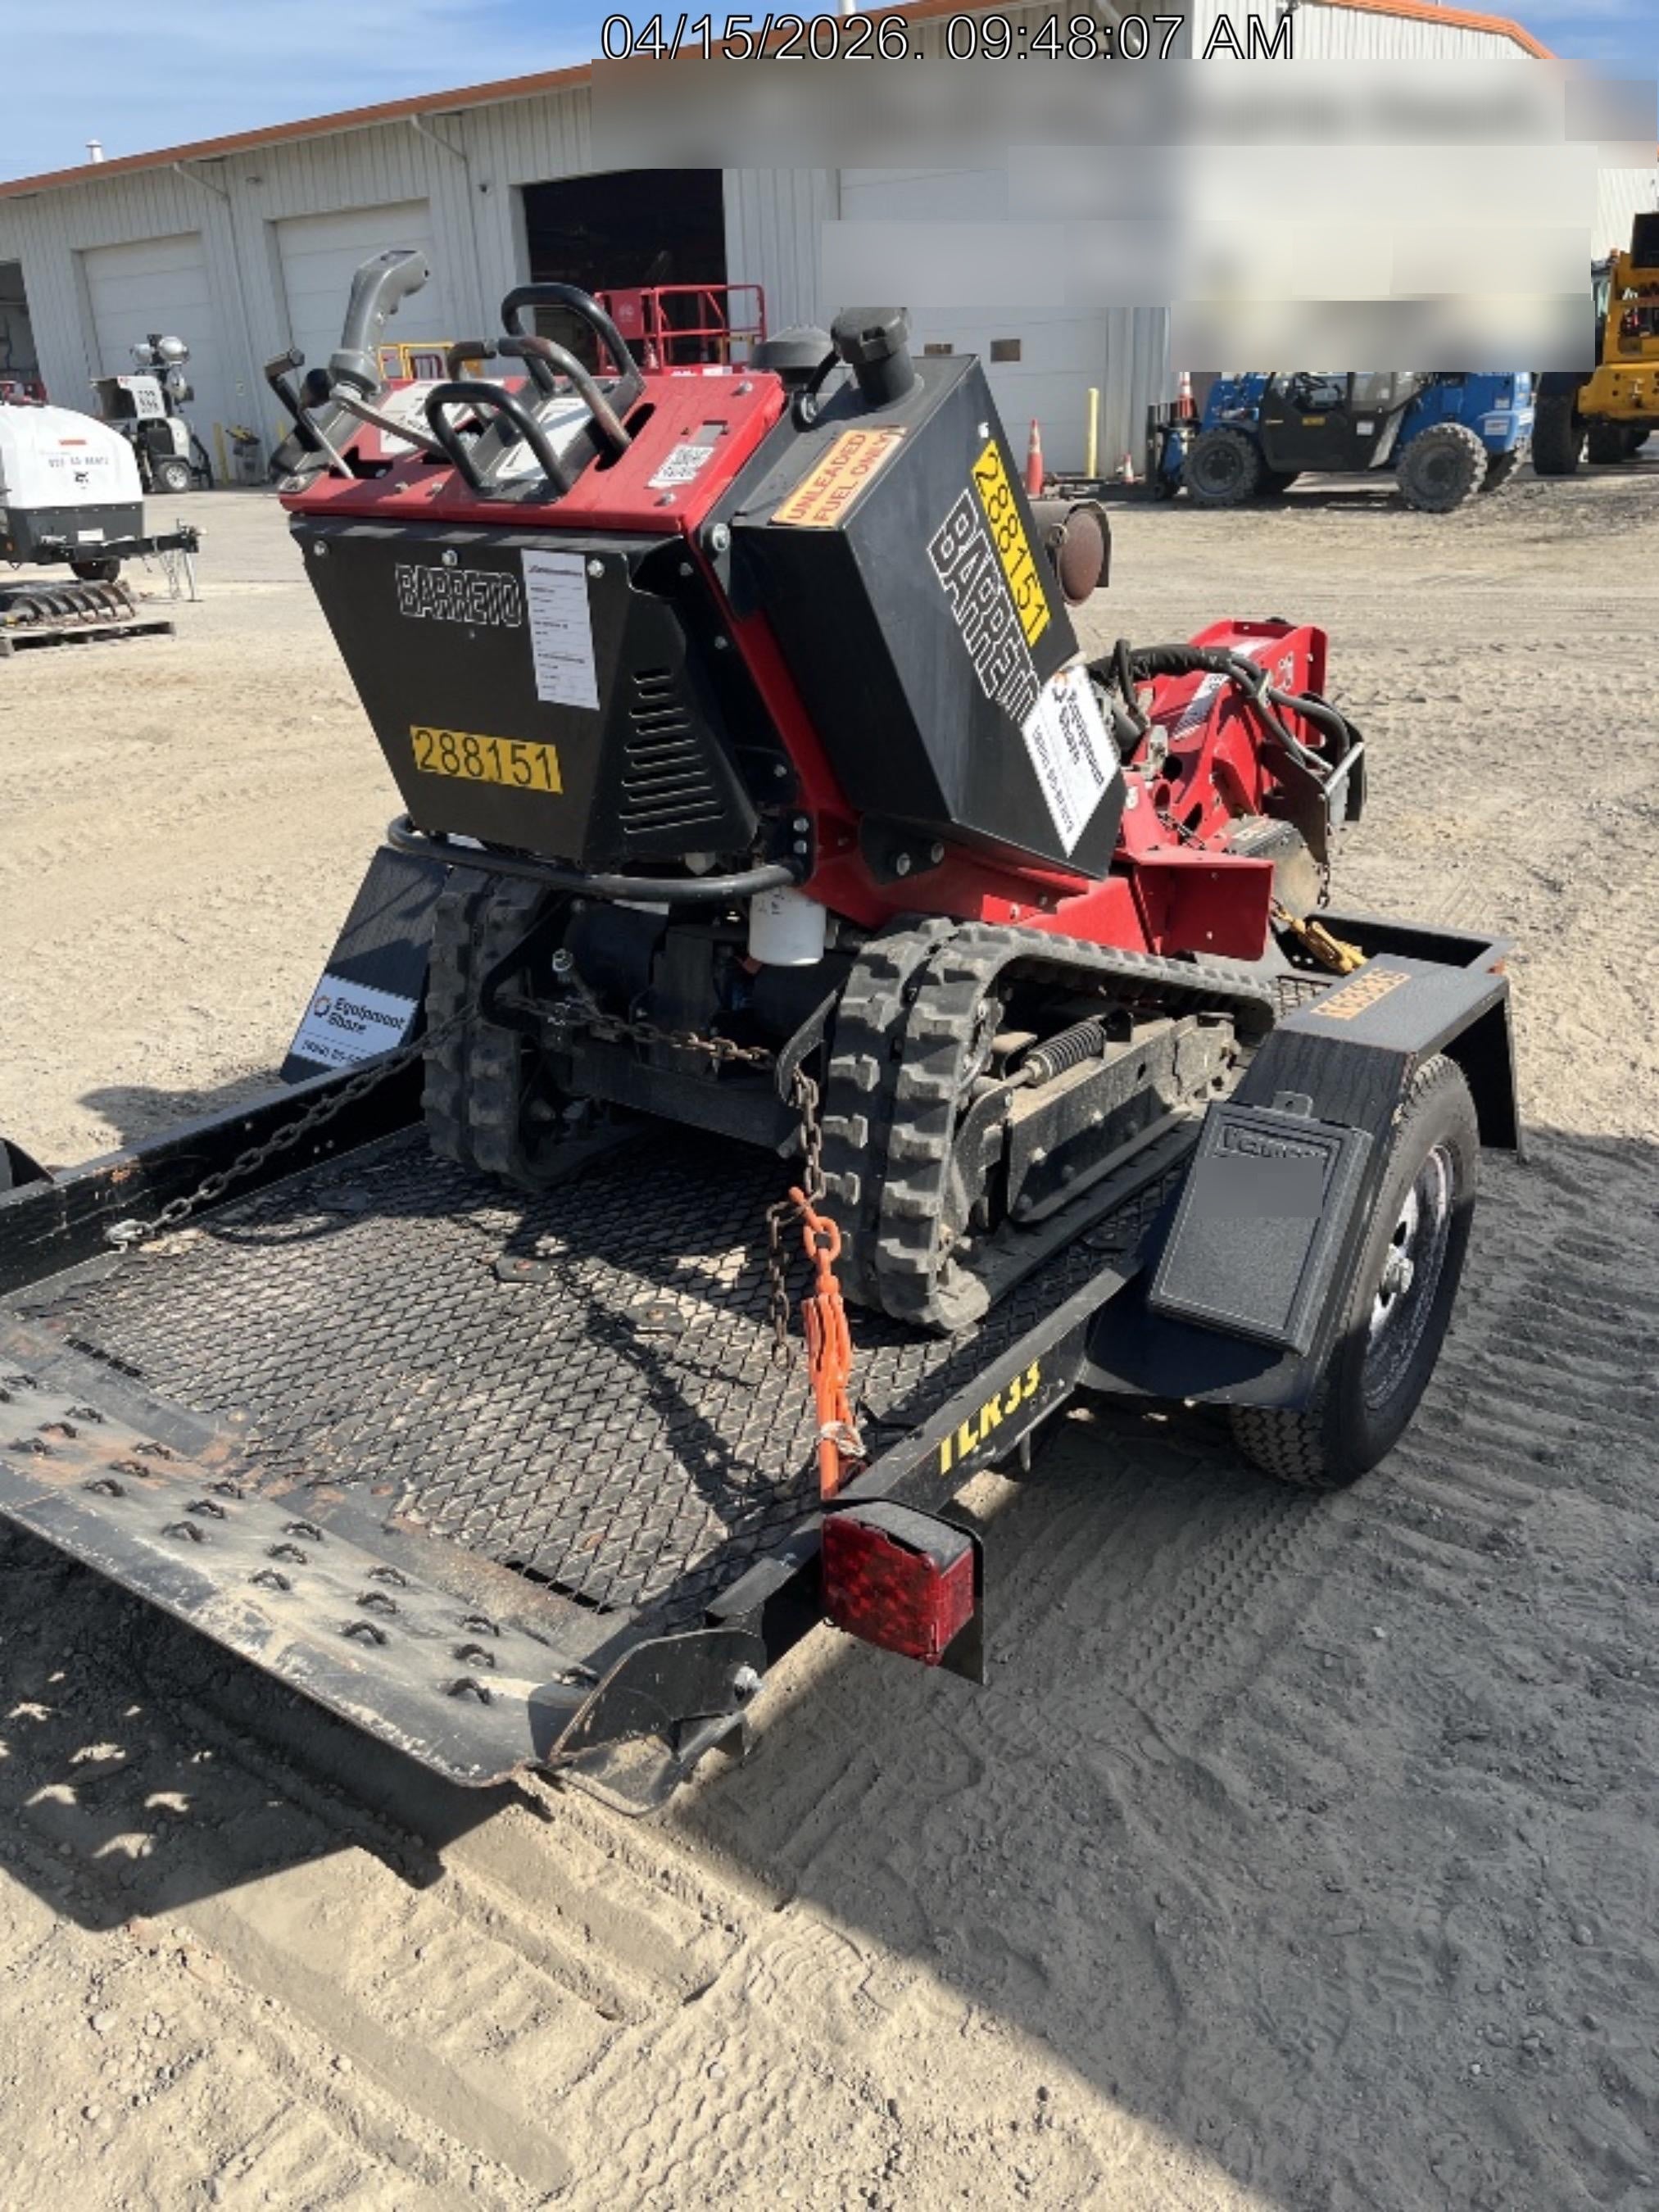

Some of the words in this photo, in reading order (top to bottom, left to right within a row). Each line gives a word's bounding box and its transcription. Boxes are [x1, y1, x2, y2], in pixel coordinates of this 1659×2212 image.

[786, 434, 866, 519] UNLEADED
[813, 481, 859, 521] FUEL
[850, 433, 891, 475] ONLY
[976, 451, 1046, 636] 288151
[396, 563, 522, 628] BARRETO
[415, 729, 552, 790] 288151
